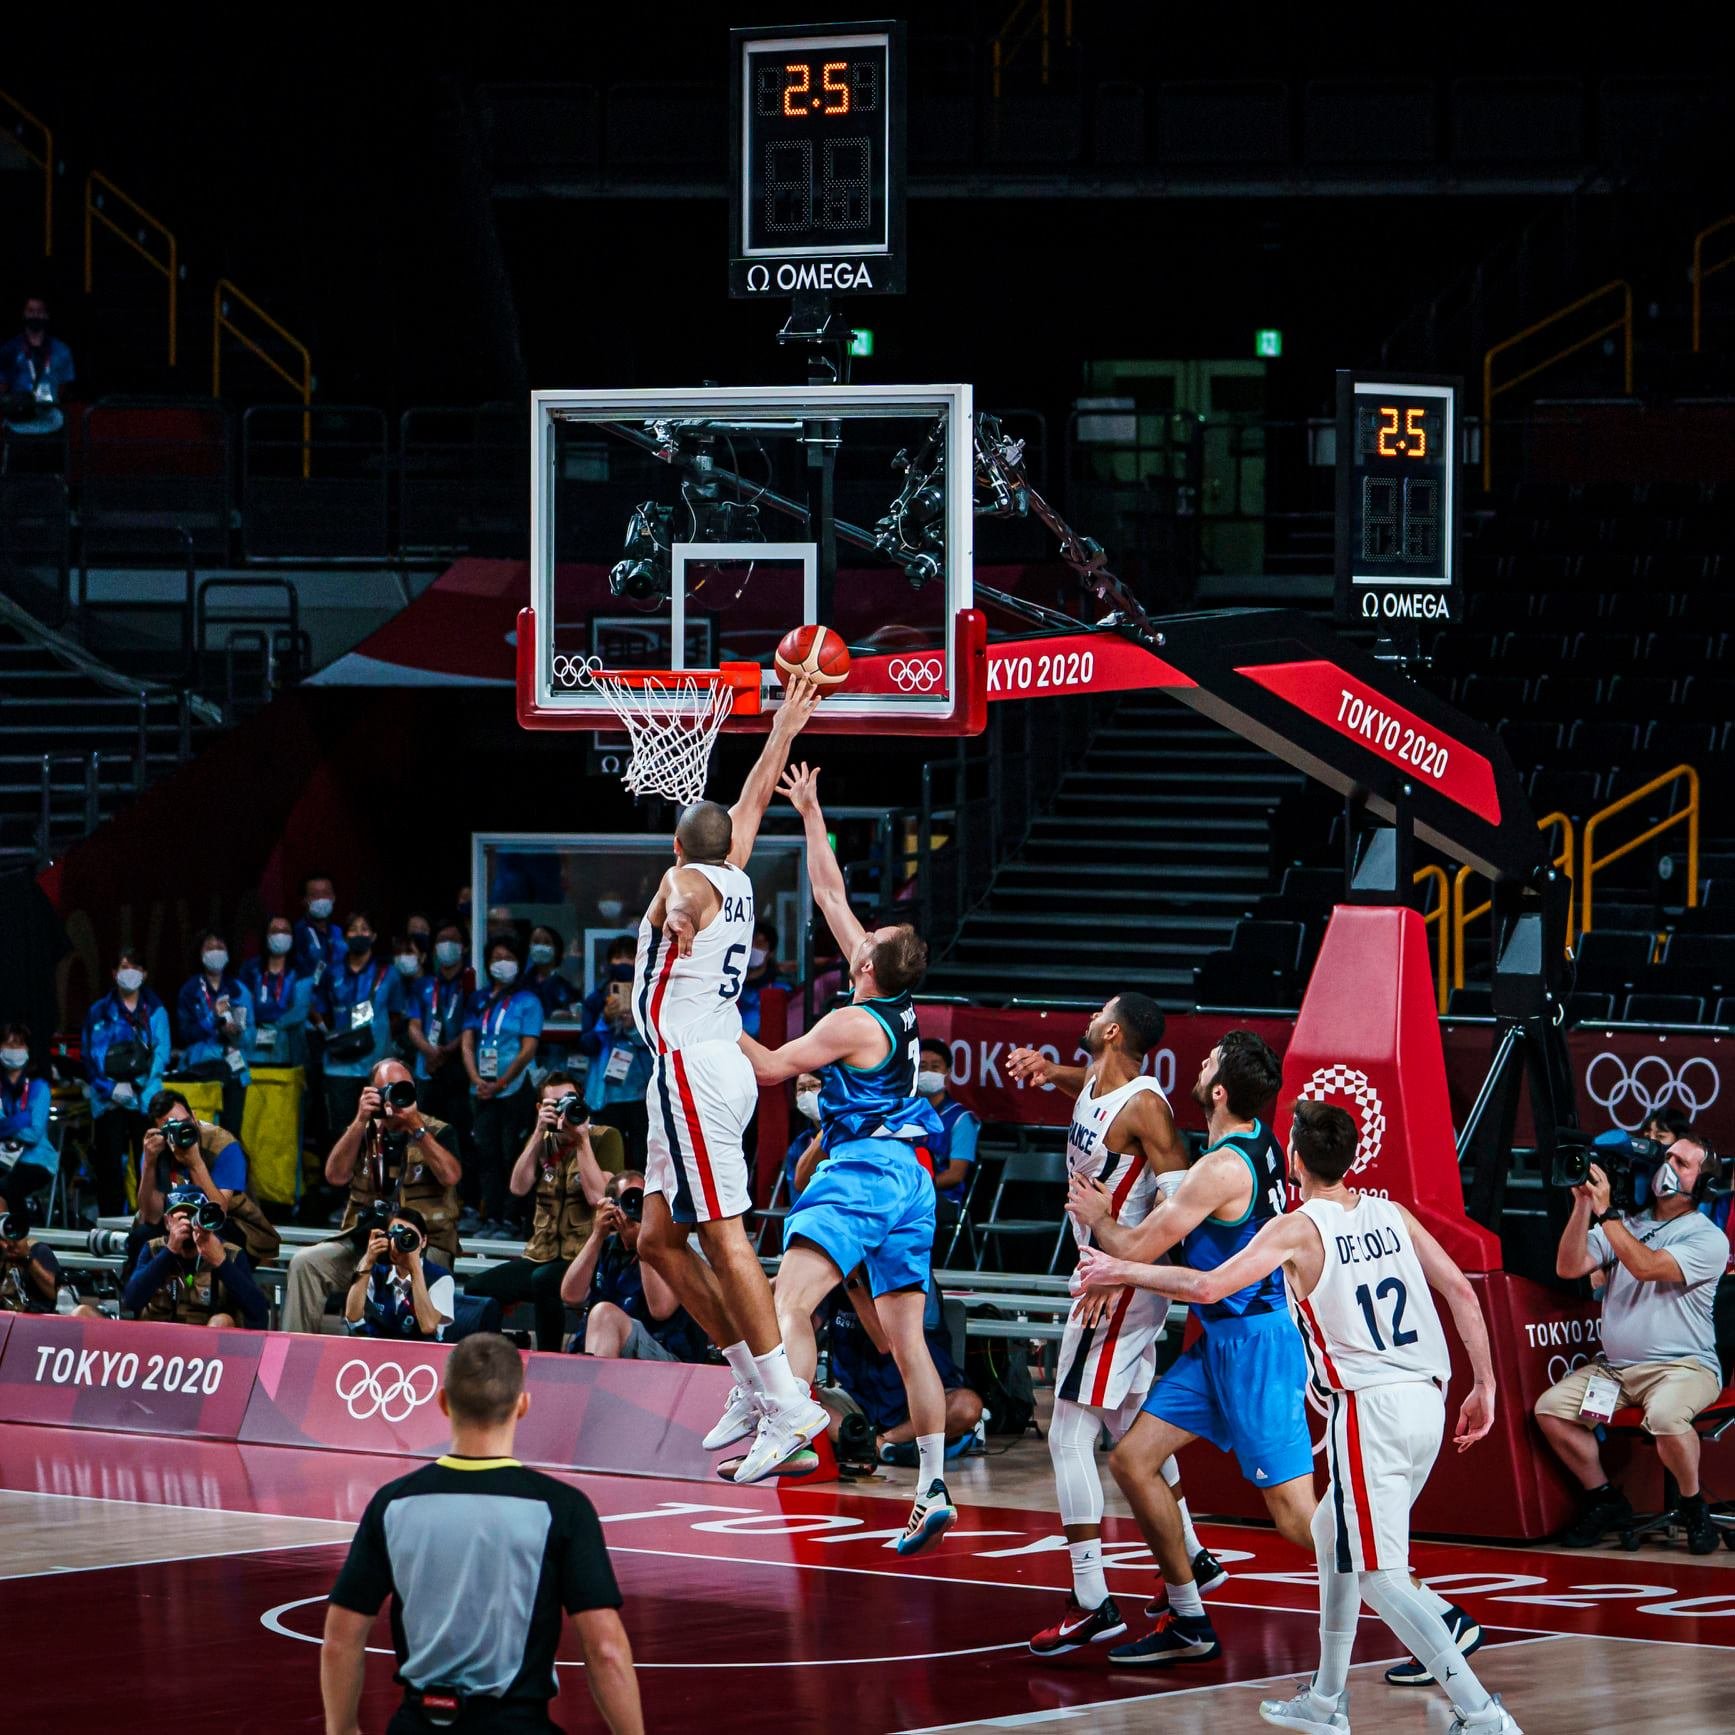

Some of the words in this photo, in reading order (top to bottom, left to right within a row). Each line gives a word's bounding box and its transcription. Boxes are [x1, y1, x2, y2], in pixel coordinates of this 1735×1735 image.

[784, 62, 849, 116] 2.5
[776, 262, 873, 290] OMEGA
[1378, 407, 1426, 457] 2.5
[1383, 593, 1450, 619] OMEGA
[986, 657, 1033, 692] KYO
[1037, 651, 1094, 688] 2020
[1337, 689, 1401, 751] TOKYO
[1398, 728, 1449, 779] 2020
[724, 896, 753, 922] BAT
[718, 943, 746, 999] 5
[1069, 1121, 1098, 1156] ANCE
[1335, 1234, 1360, 1265] DE
[1355, 1276, 1419, 1352] 12
[1524, 1320, 1583, 1348] TOKYO
[1585, 1317, 1602, 1342] 20
[35, 1345, 139, 1390] TOKYO
[141, 1355, 225, 1396] 2020
